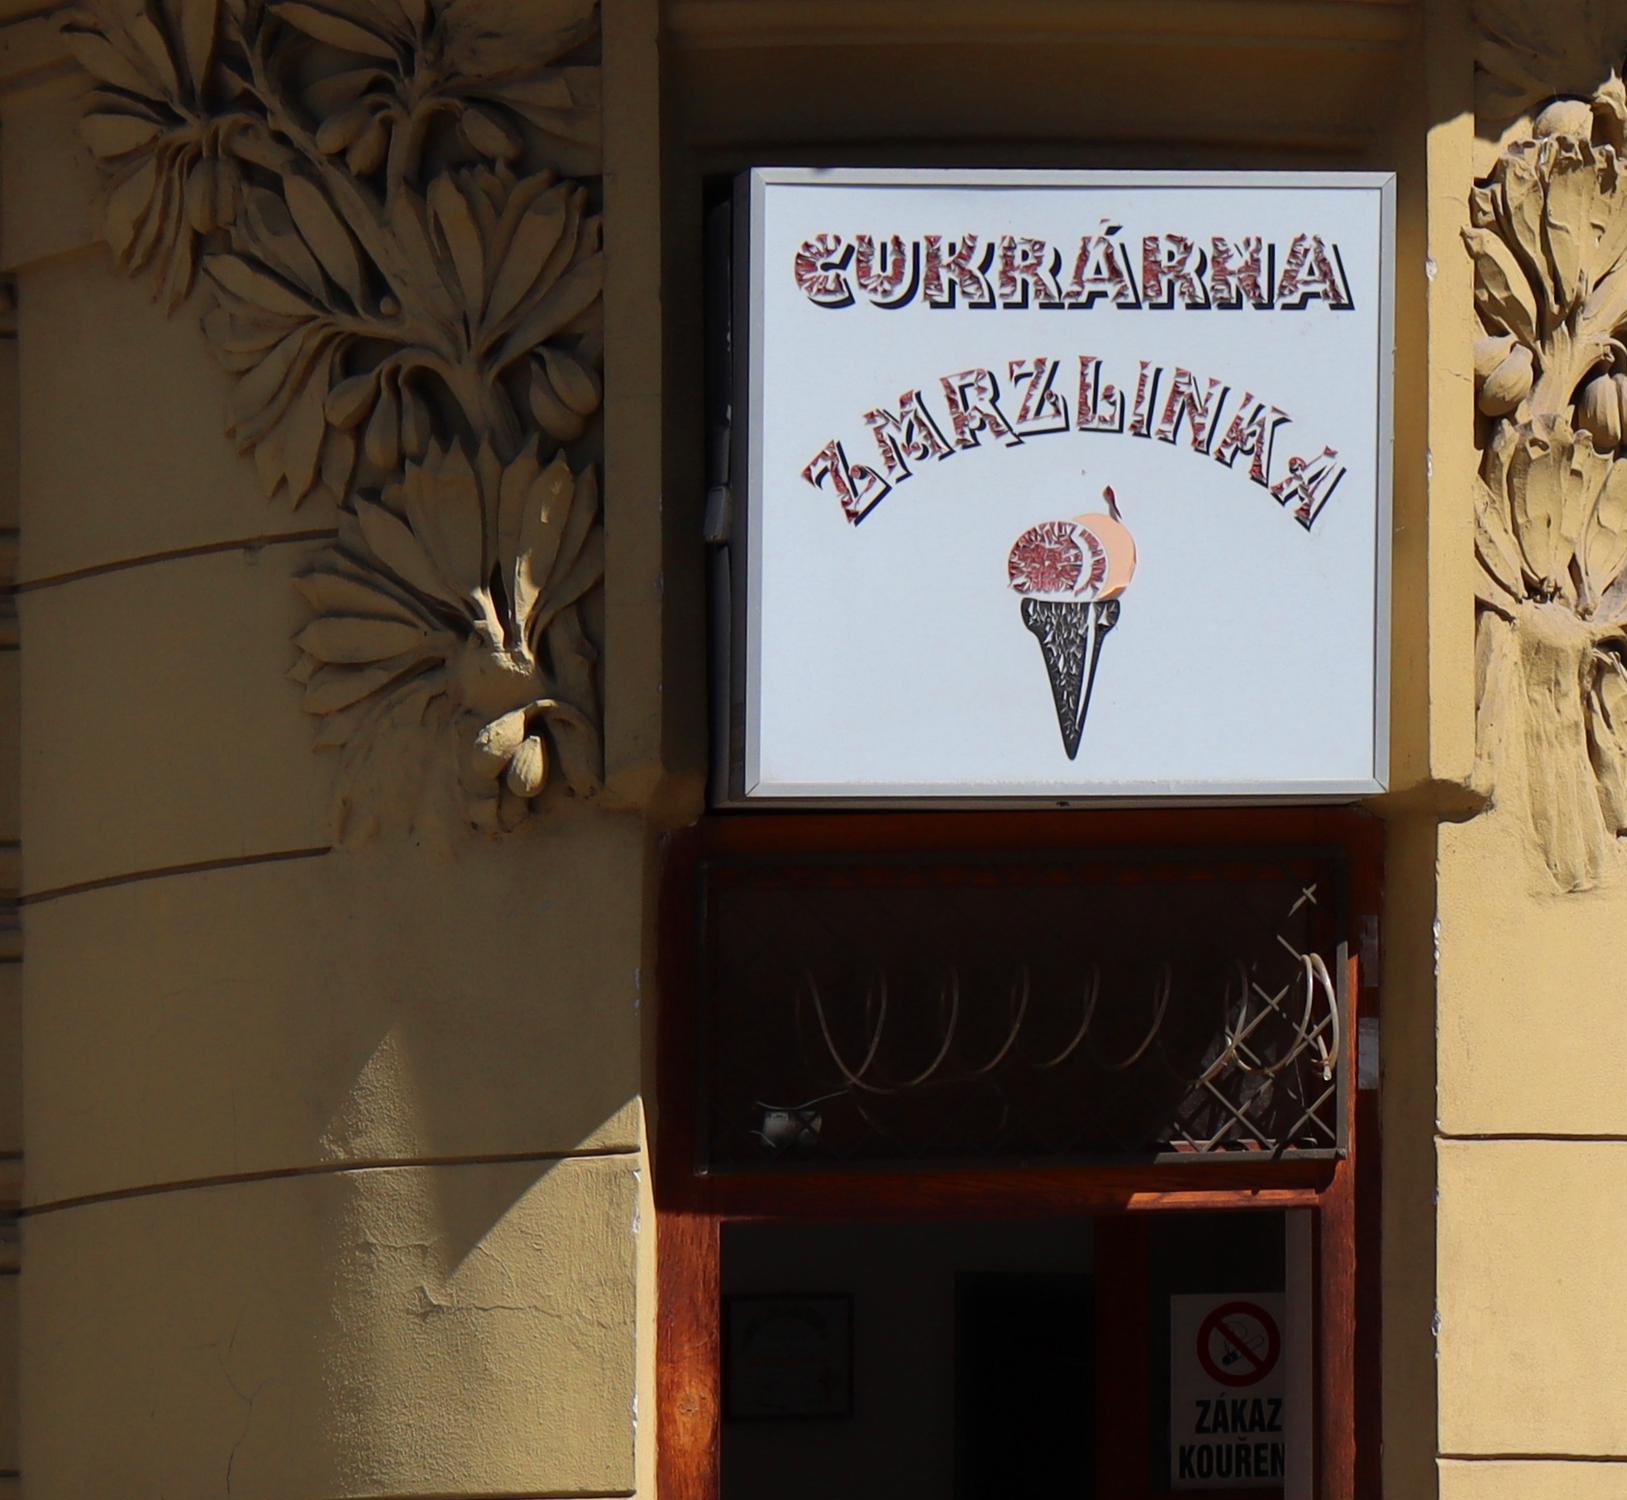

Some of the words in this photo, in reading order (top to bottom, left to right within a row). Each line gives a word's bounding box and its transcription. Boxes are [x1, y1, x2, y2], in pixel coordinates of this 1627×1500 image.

[794, 218, 1356, 310] CUKRÁRNA
[800, 355, 1347, 532] ZMRZLINKA
[1194, 1391, 1283, 1434] ZÁKAZ
